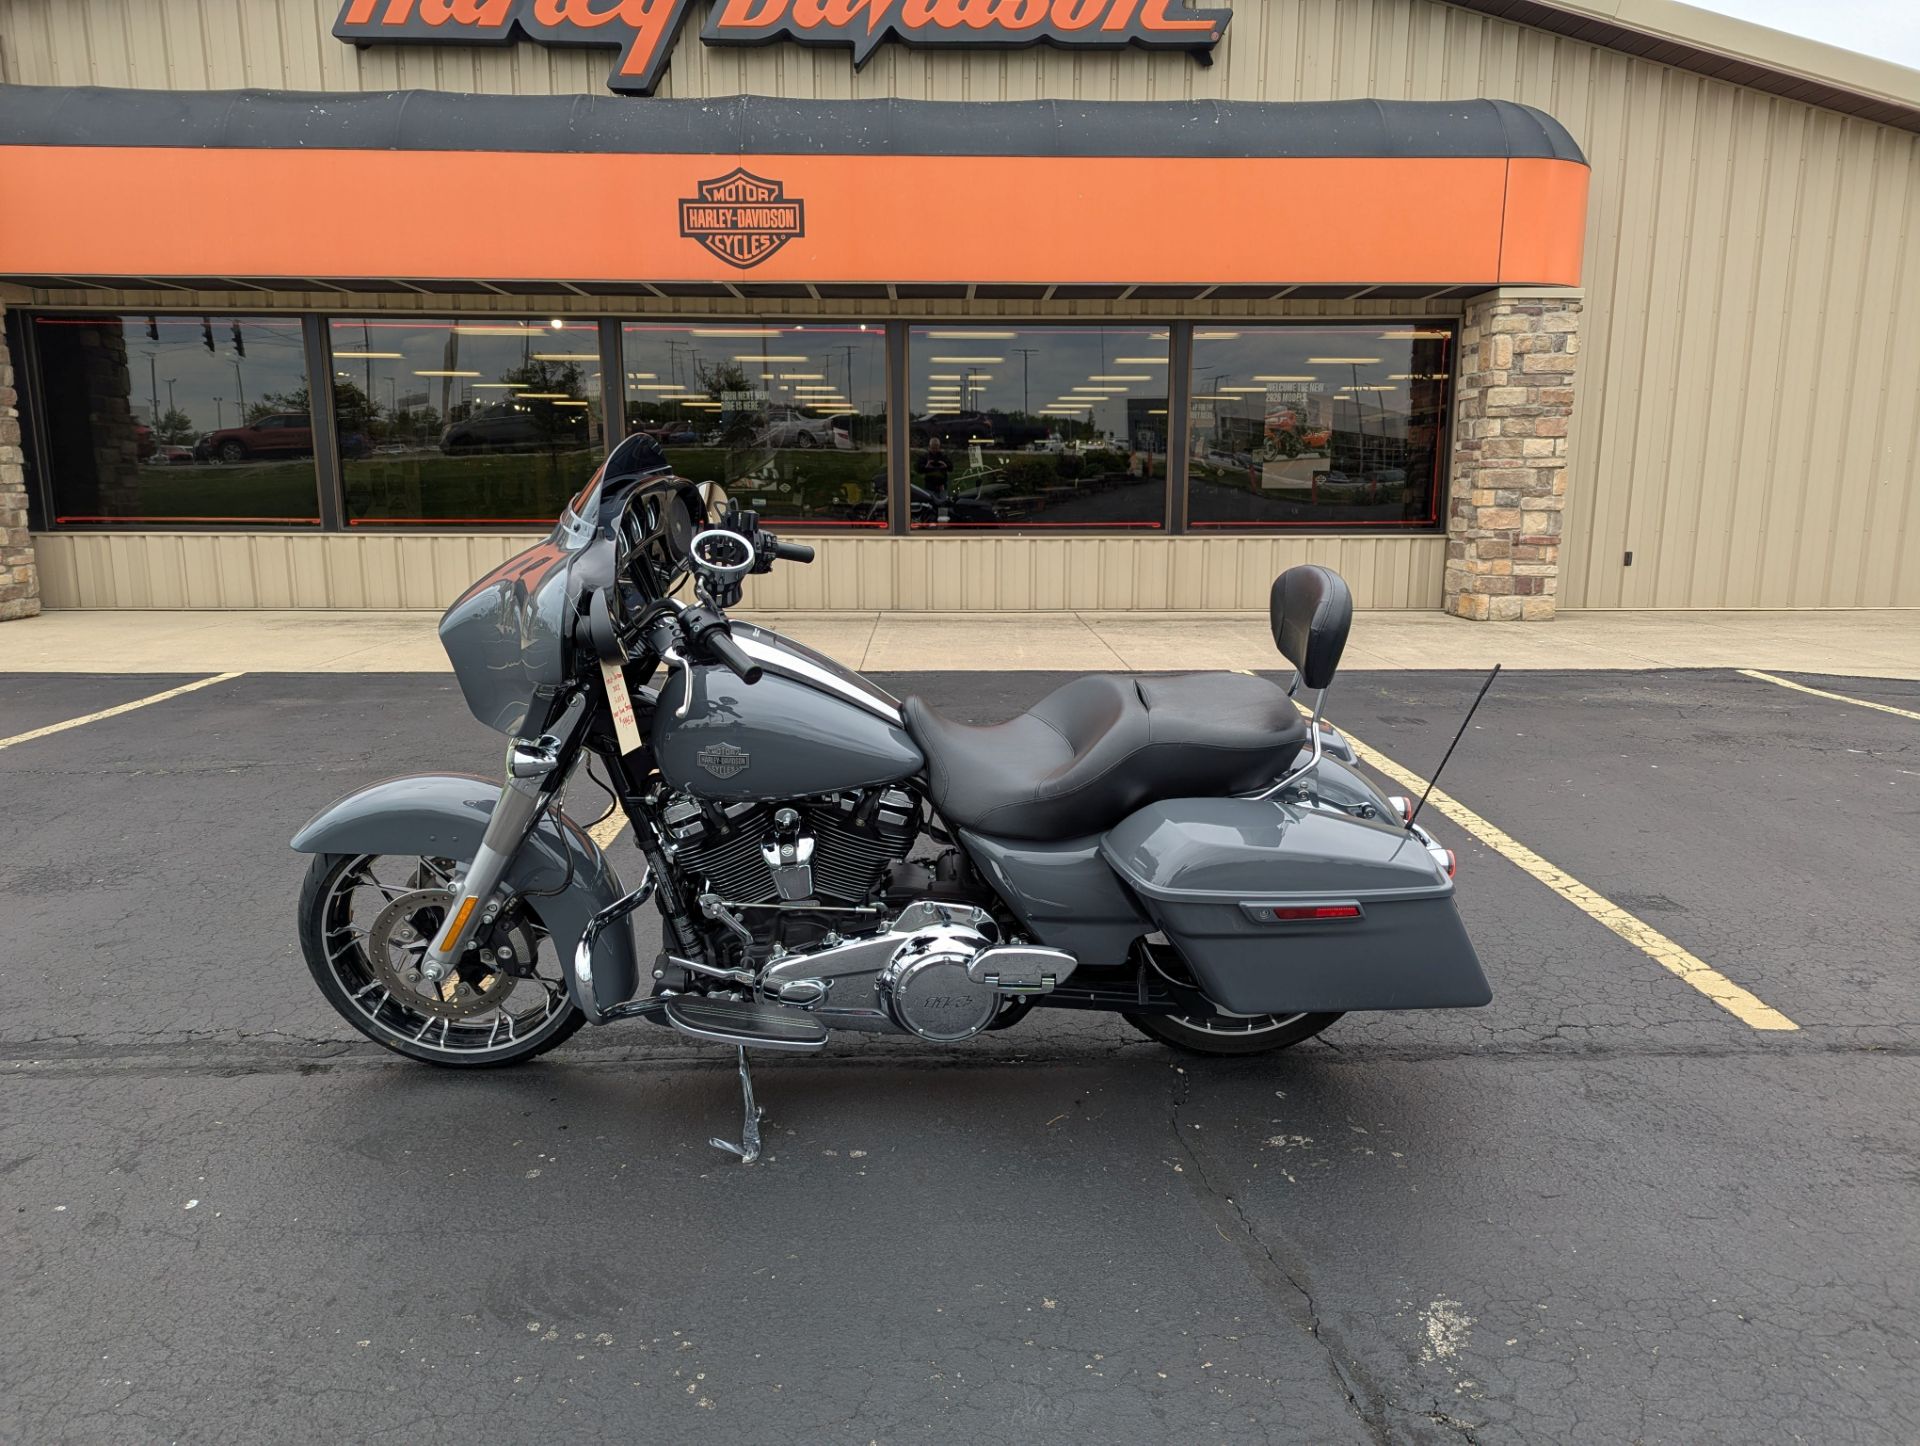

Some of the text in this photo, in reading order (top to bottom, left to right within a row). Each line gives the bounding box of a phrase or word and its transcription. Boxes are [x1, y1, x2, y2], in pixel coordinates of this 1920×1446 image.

[713, 180, 769, 202] MOTOR
[689, 208, 795, 228] HARLEY-DAVIDSON
[715, 235, 771, 260] CYCLES
[1266, 382, 1325, 393] WELCOME THE NEW
